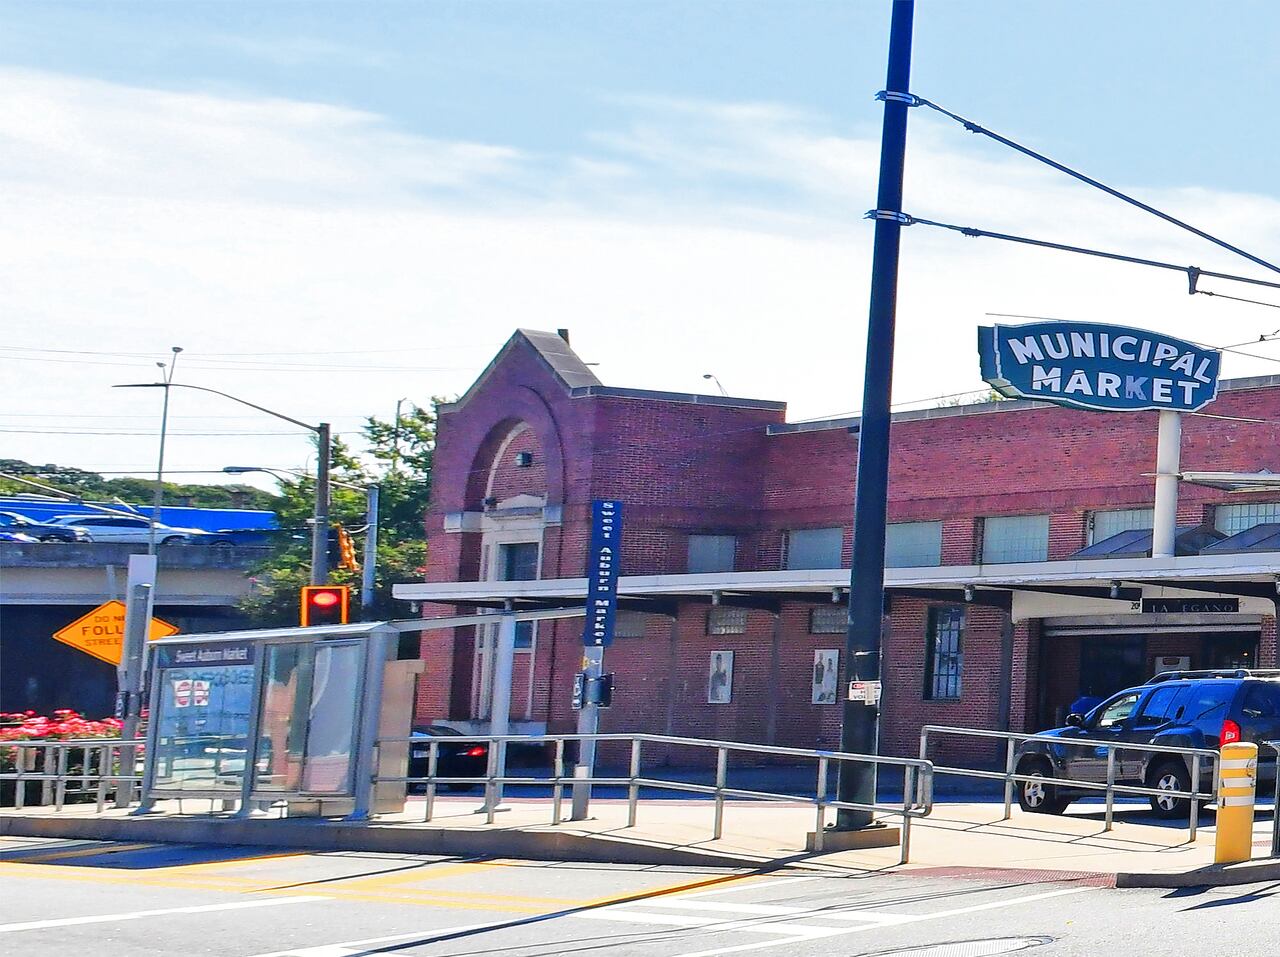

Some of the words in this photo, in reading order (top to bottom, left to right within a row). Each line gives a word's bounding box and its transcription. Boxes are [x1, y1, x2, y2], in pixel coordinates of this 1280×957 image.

[1007, 332, 1212, 384] MUNICIPAL
[1031, 365, 1200, 405] MARKET
[82, 626, 124, 636] FOLL
